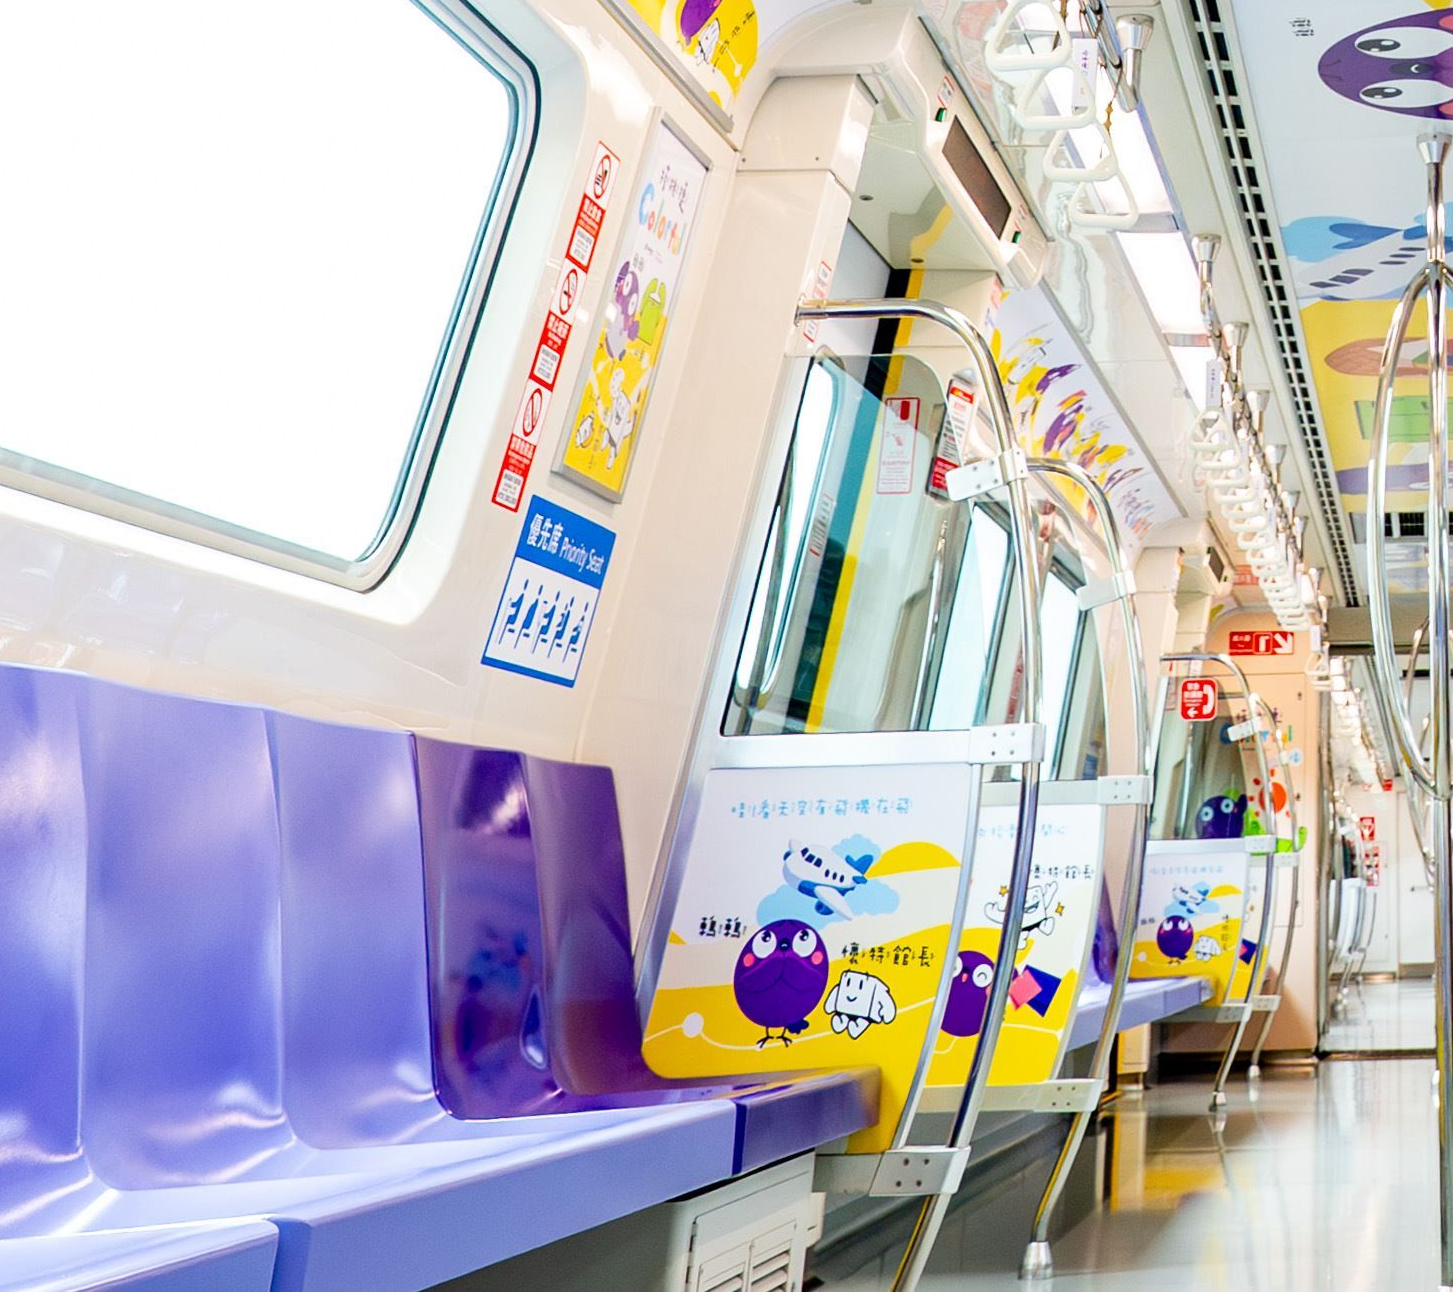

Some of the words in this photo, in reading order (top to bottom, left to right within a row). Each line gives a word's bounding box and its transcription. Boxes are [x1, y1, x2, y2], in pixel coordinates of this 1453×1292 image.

[526, 512, 564, 555] 優先席
[558, 536, 589, 573] Priority
[586, 548, 605, 575] Seat
